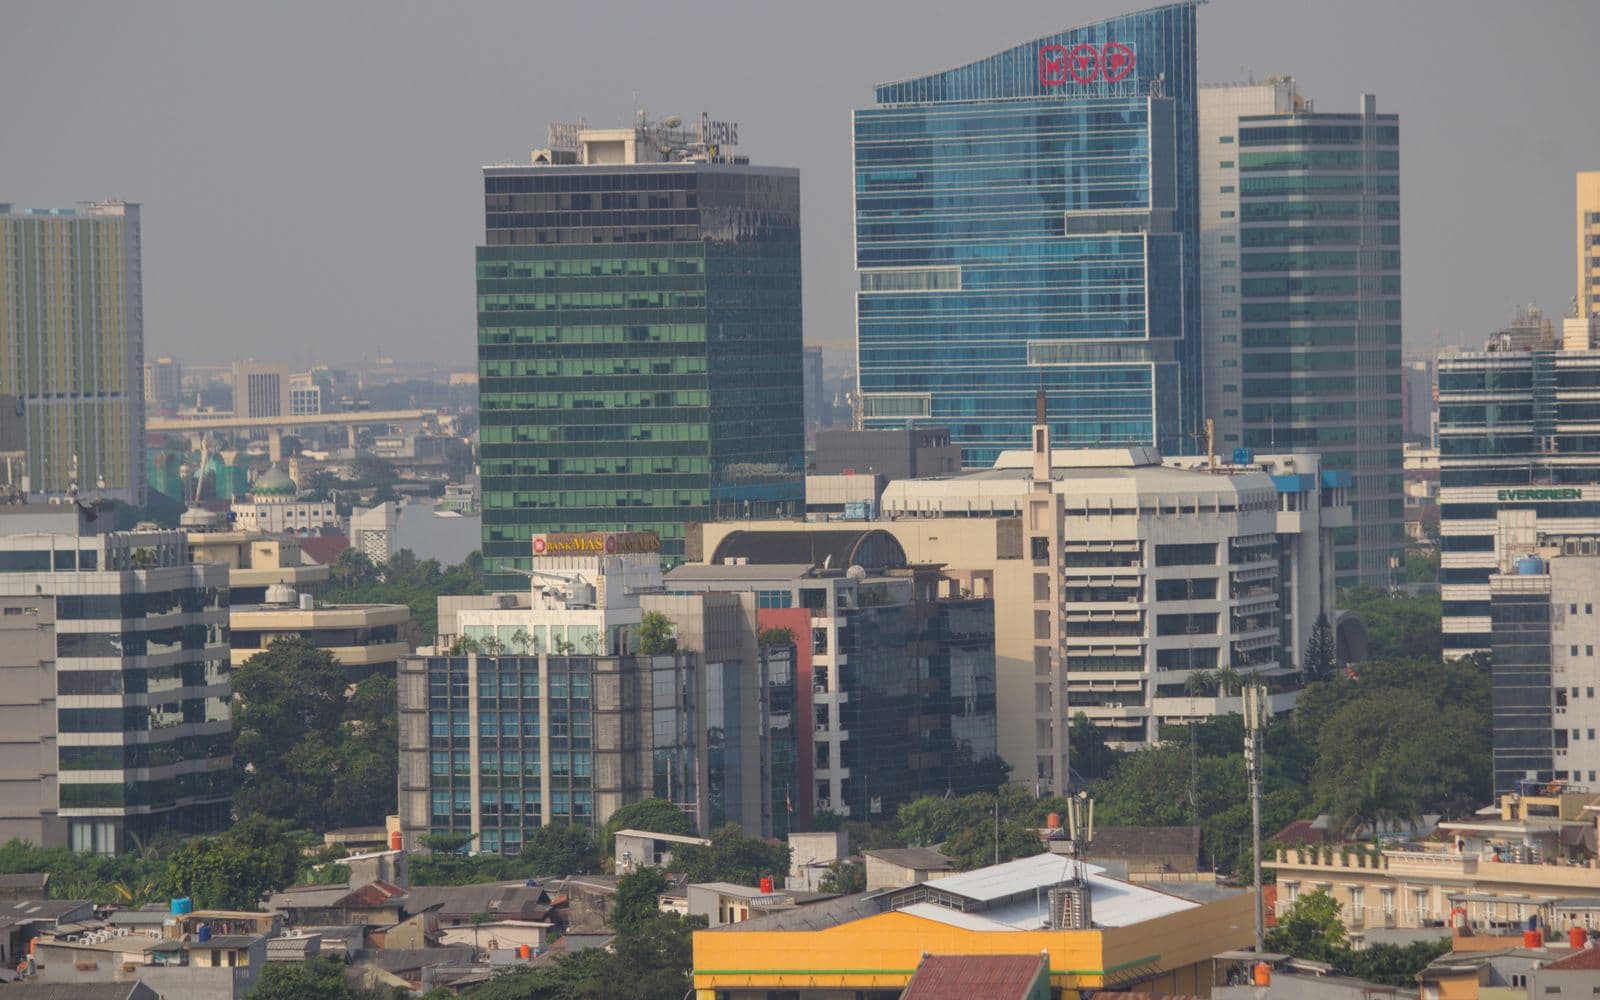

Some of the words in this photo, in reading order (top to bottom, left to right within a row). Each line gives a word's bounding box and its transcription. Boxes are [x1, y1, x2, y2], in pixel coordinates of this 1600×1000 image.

[1497, 488, 1582, 501] EVERGREEN
[547, 542, 572, 551] BANK
[572, 537, 604, 551] MAS
